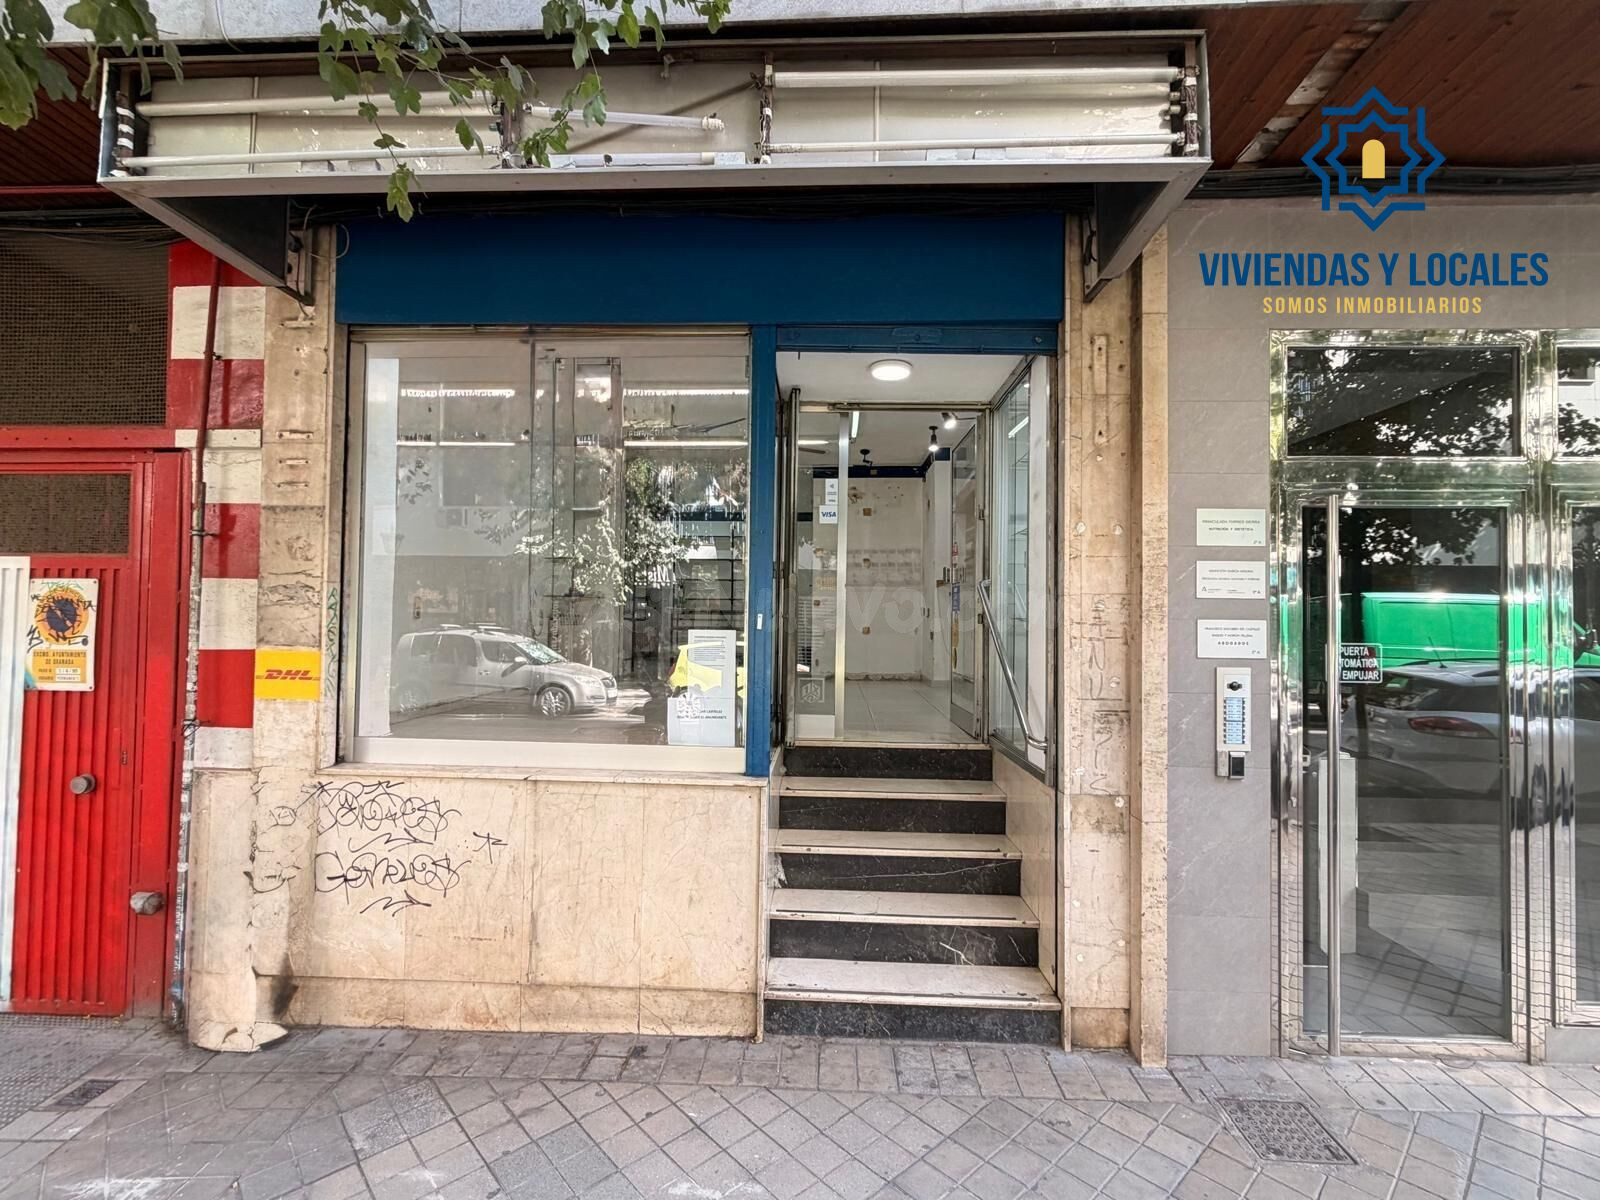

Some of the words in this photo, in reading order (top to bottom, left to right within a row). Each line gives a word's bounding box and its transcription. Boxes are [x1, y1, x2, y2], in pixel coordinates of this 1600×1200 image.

[1339, 646, 1369, 656] PUERTA
[1340, 656, 1379, 668] TOMÁTICA
[265, 669, 313, 681] DHL
[1342, 670, 1379, 680] EMPUJAR
